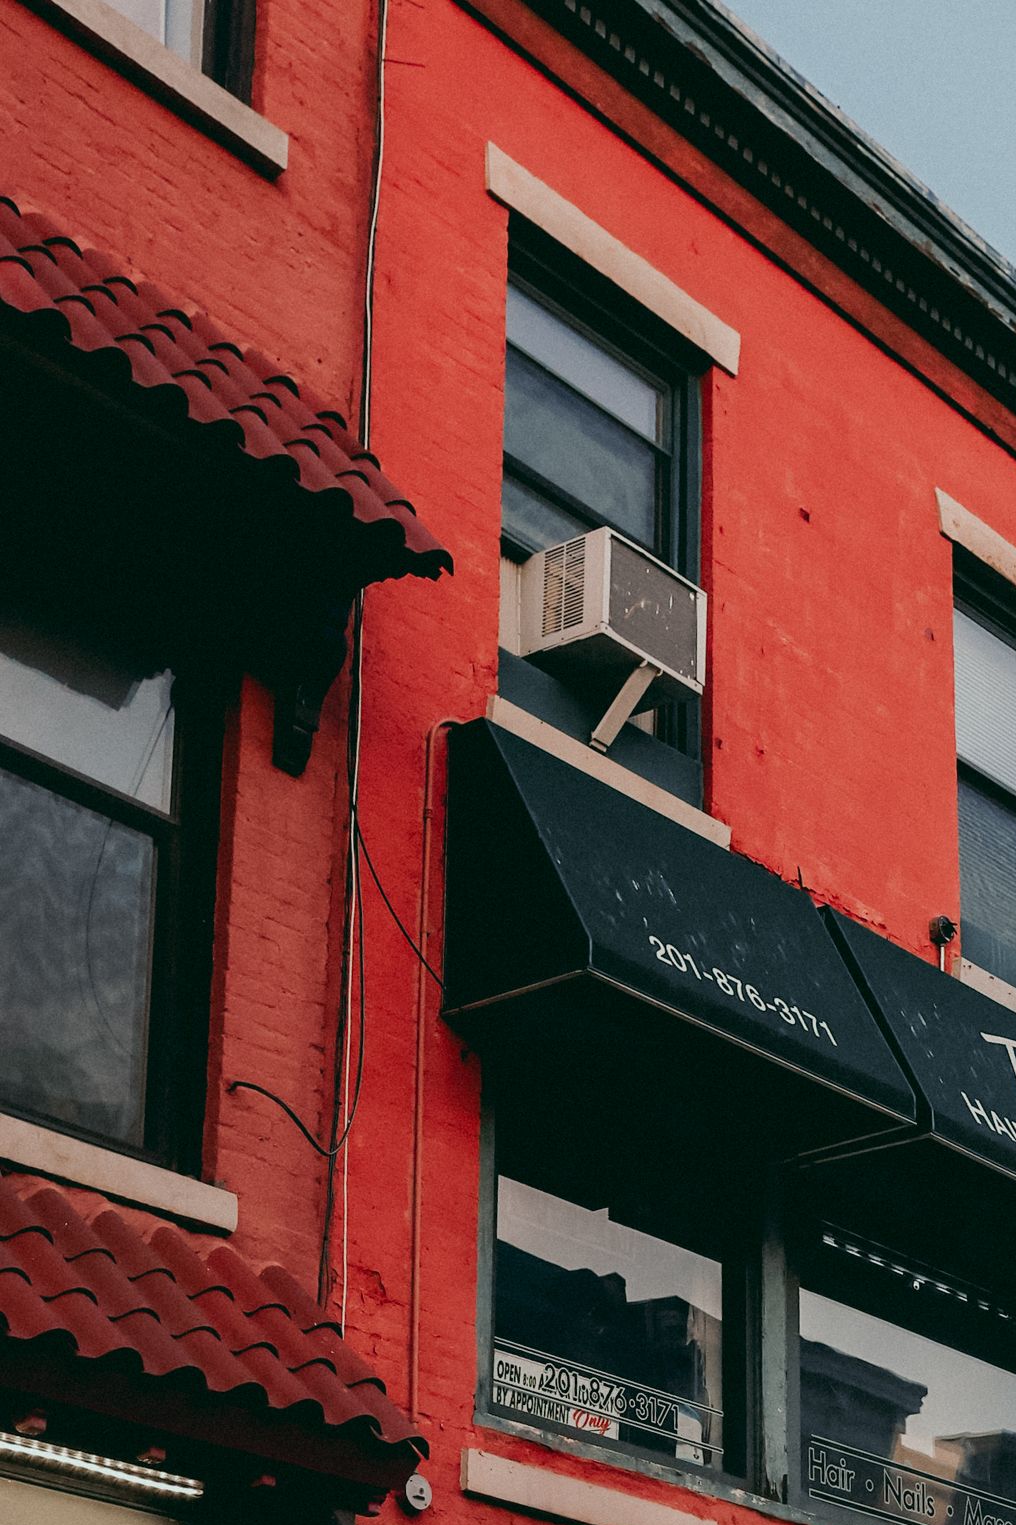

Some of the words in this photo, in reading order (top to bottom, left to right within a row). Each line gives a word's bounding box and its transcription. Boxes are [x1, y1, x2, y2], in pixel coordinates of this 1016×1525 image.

[648, 935, 838, 1047] 201-876-3171
[497, 1360, 521, 1384] OPEN
[496, 1387, 508, 1403] BY
[509, 1389, 571, 1424] APPOINTMENT
[572, 1409, 611, 1435] Only
[808, 1446, 856, 1492] Hair
[883, 1467, 935, 1518] Nails
